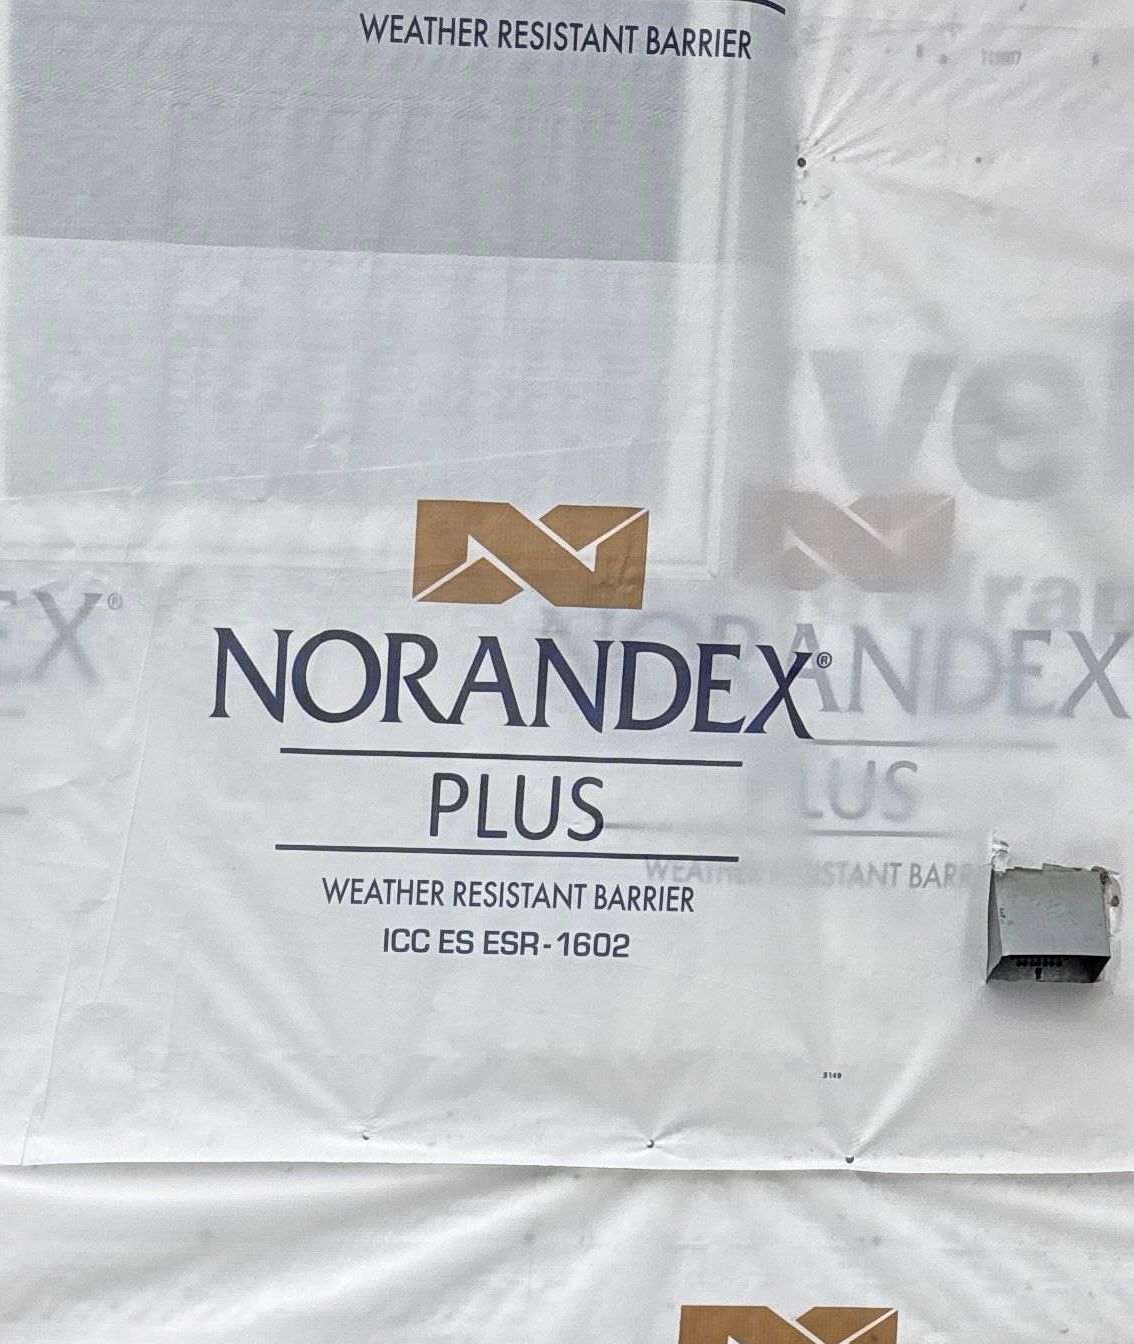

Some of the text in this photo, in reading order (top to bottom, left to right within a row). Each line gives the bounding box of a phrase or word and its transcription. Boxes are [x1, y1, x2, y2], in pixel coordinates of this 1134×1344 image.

[359, 12, 753, 60] WEATHER RESISTANT BARRIER
[209, 627, 833, 739] NORANDEX®
[428, 772, 605, 841] PLUS
[791, 757, 919, 824] LUS
[321, 877, 696, 913] WEATHER RESISTANT BARRIER
[383, 927, 631, 958] ICC ES ESR-1602
